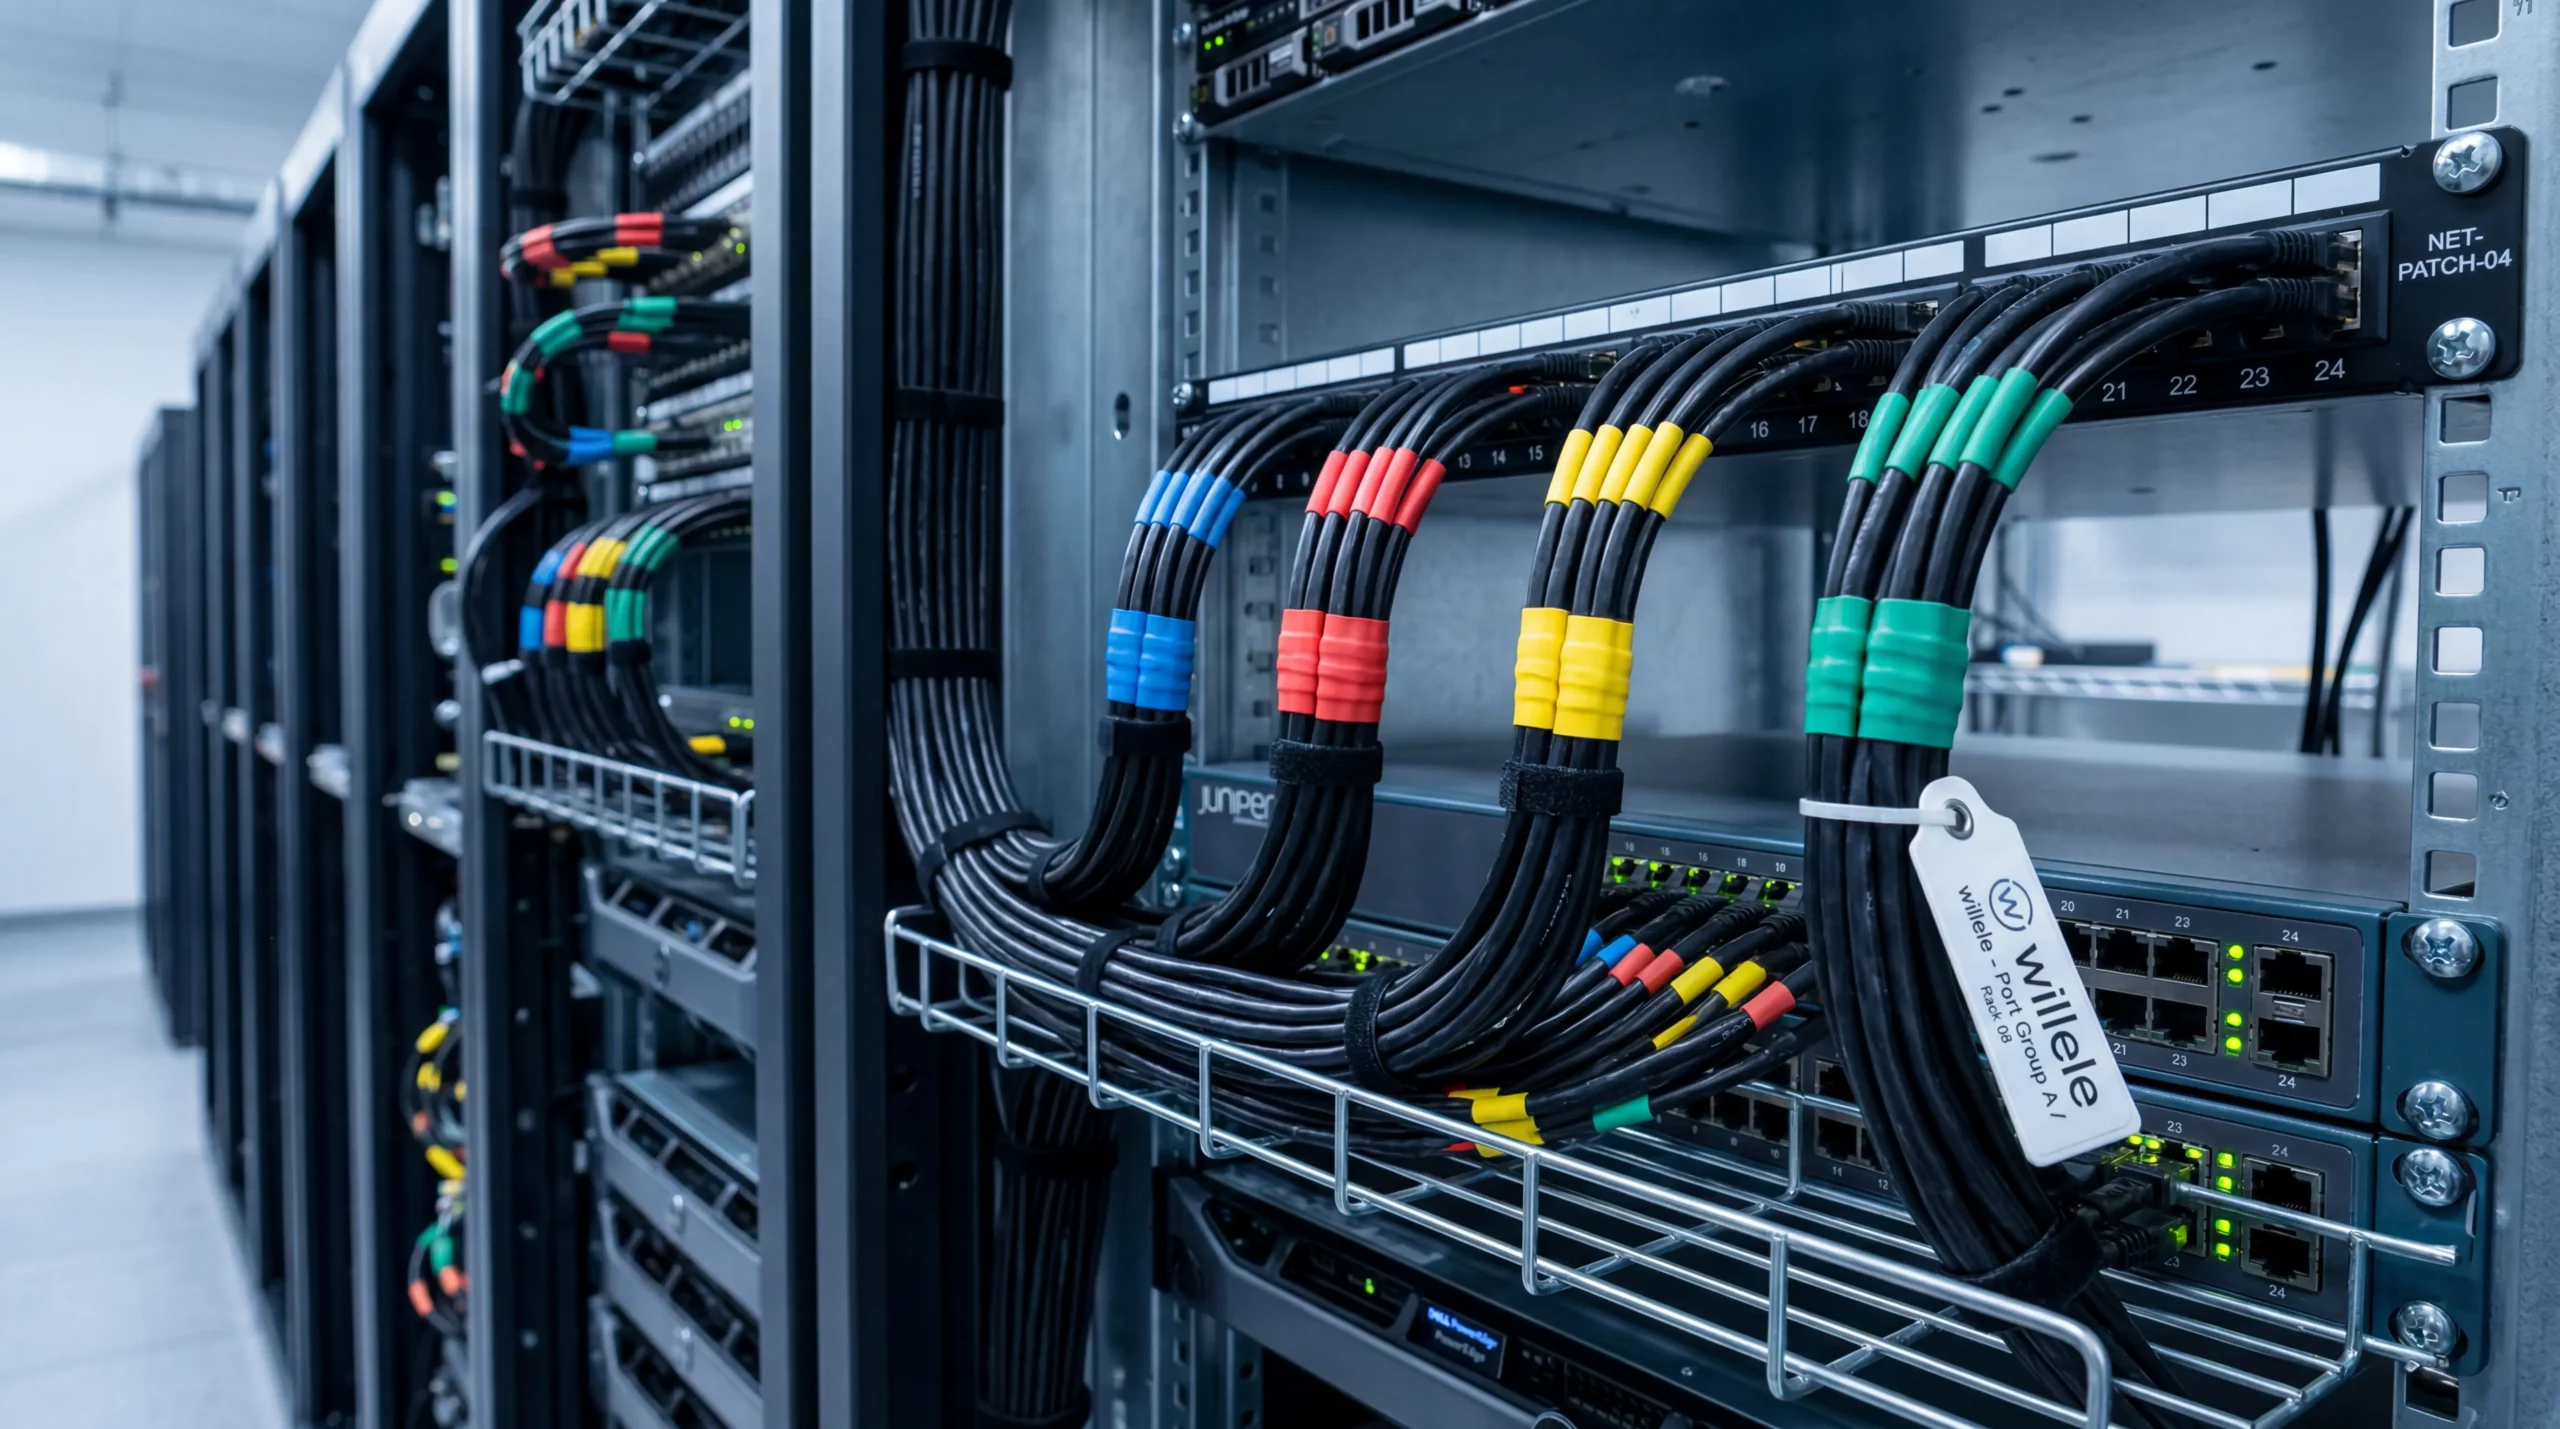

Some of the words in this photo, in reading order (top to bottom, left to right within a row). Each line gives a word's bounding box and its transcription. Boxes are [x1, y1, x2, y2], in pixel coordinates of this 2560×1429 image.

[2428, 227, 2484, 252] NET-
[2398, 247, 2513, 281] PATCH-04
[2240, 366, 2271, 389] 23
[2314, 357, 2346, 382] 24
[2102, 381, 2127, 402] 21
[2169, 374, 2198, 396] 22
[1798, 414, 1819, 434] 17
[1848, 409, 1870, 429] 18
[1750, 420, 1770, 439] 16
[1491, 449, 1507, 466] 14
[1528, 444, 1544, 461] 15
[1457, 453, 1472, 470] 13
[2060, 900, 2076, 912] 20
[2115, 907, 2131, 920] 21
[2174, 915, 2191, 928] 23
[2281, 928, 2300, 942] 24
[1958, 884, 1994, 953] willele
[1995, 971, 2024, 1018] Port
[2015, 1020, 2048, 1085] Group
[2041, 1091, 2059, 1108] A
[1980, 984, 2003, 1022] Rack
[1996, 1024, 2013, 1044] 08
[2016, 942, 2099, 1108] willele
[2112, 1042, 2128, 1057] 21
[2171, 1052, 2188, 1067] 23
[2277, 1073, 2297, 1090] 24
[2166, 1119, 2183, 1134] 23
[2271, 1143, 2290, 1158] 24
[1878, 1178, 1889, 1191] 12
[2268, 1284, 2287, 1300] 24
